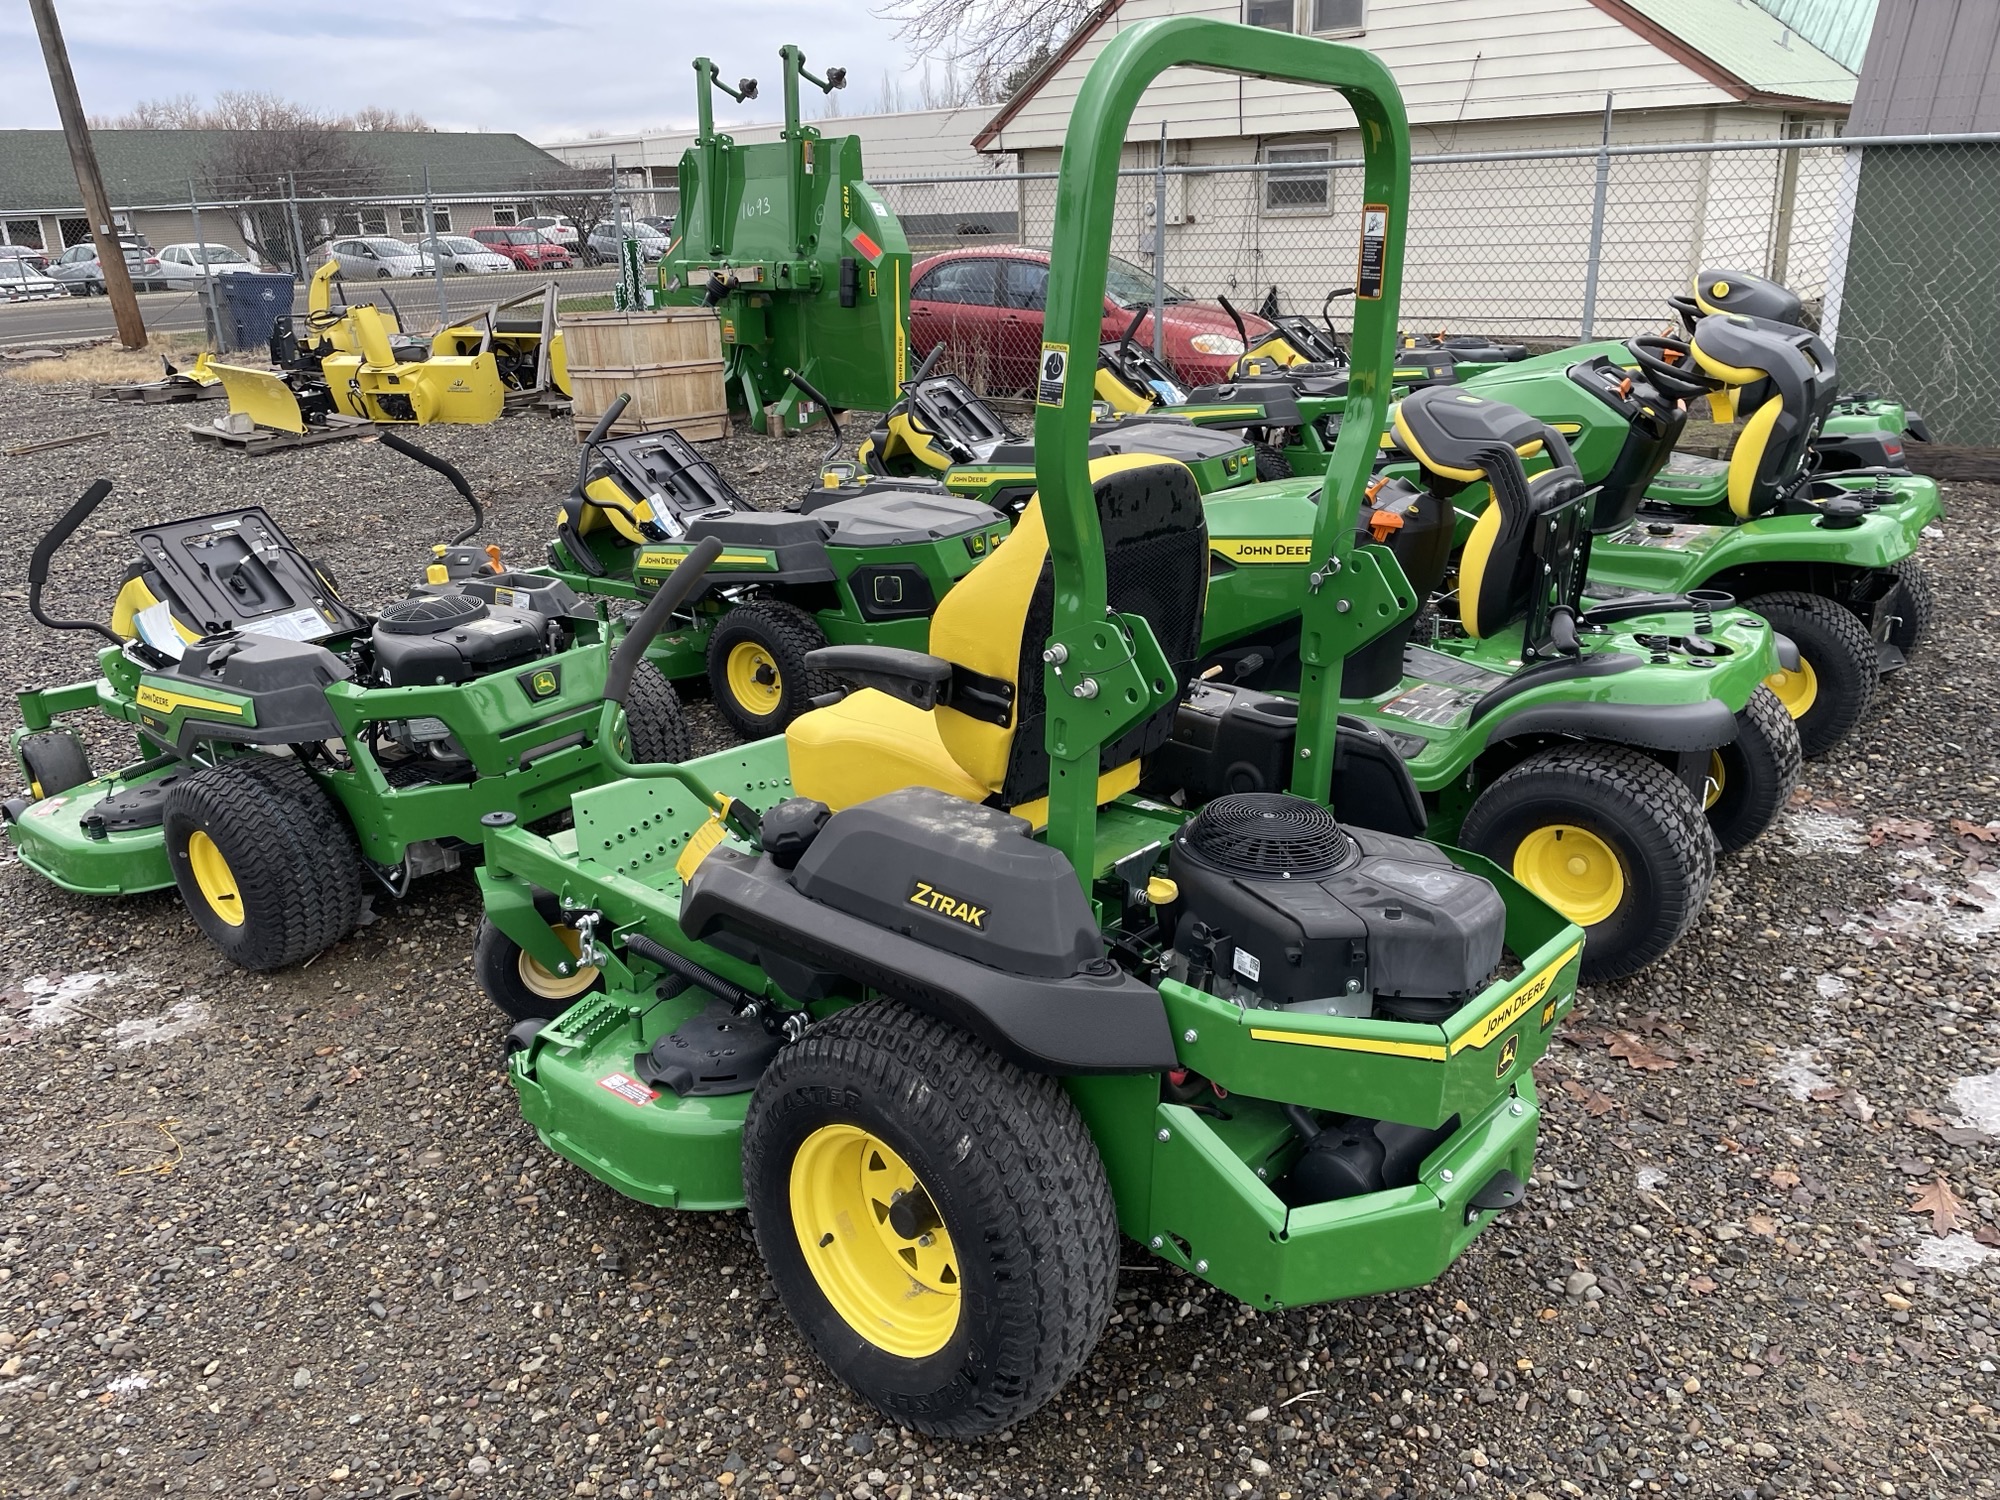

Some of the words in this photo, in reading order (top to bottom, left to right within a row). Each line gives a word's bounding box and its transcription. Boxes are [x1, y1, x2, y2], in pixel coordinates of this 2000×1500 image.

[1236, 544, 1272, 555] JOHN
[1275, 544, 1312, 555] DEER
[645, 556, 660, 564] JOHN
[141, 690, 153, 702] JOHN
[152, 693, 169, 707] DEERE
[910, 882, 986, 927] ZTRAK
[1483, 1004, 1513, 1038] JOHN
[1513, 977, 1546, 1013] DEERE
